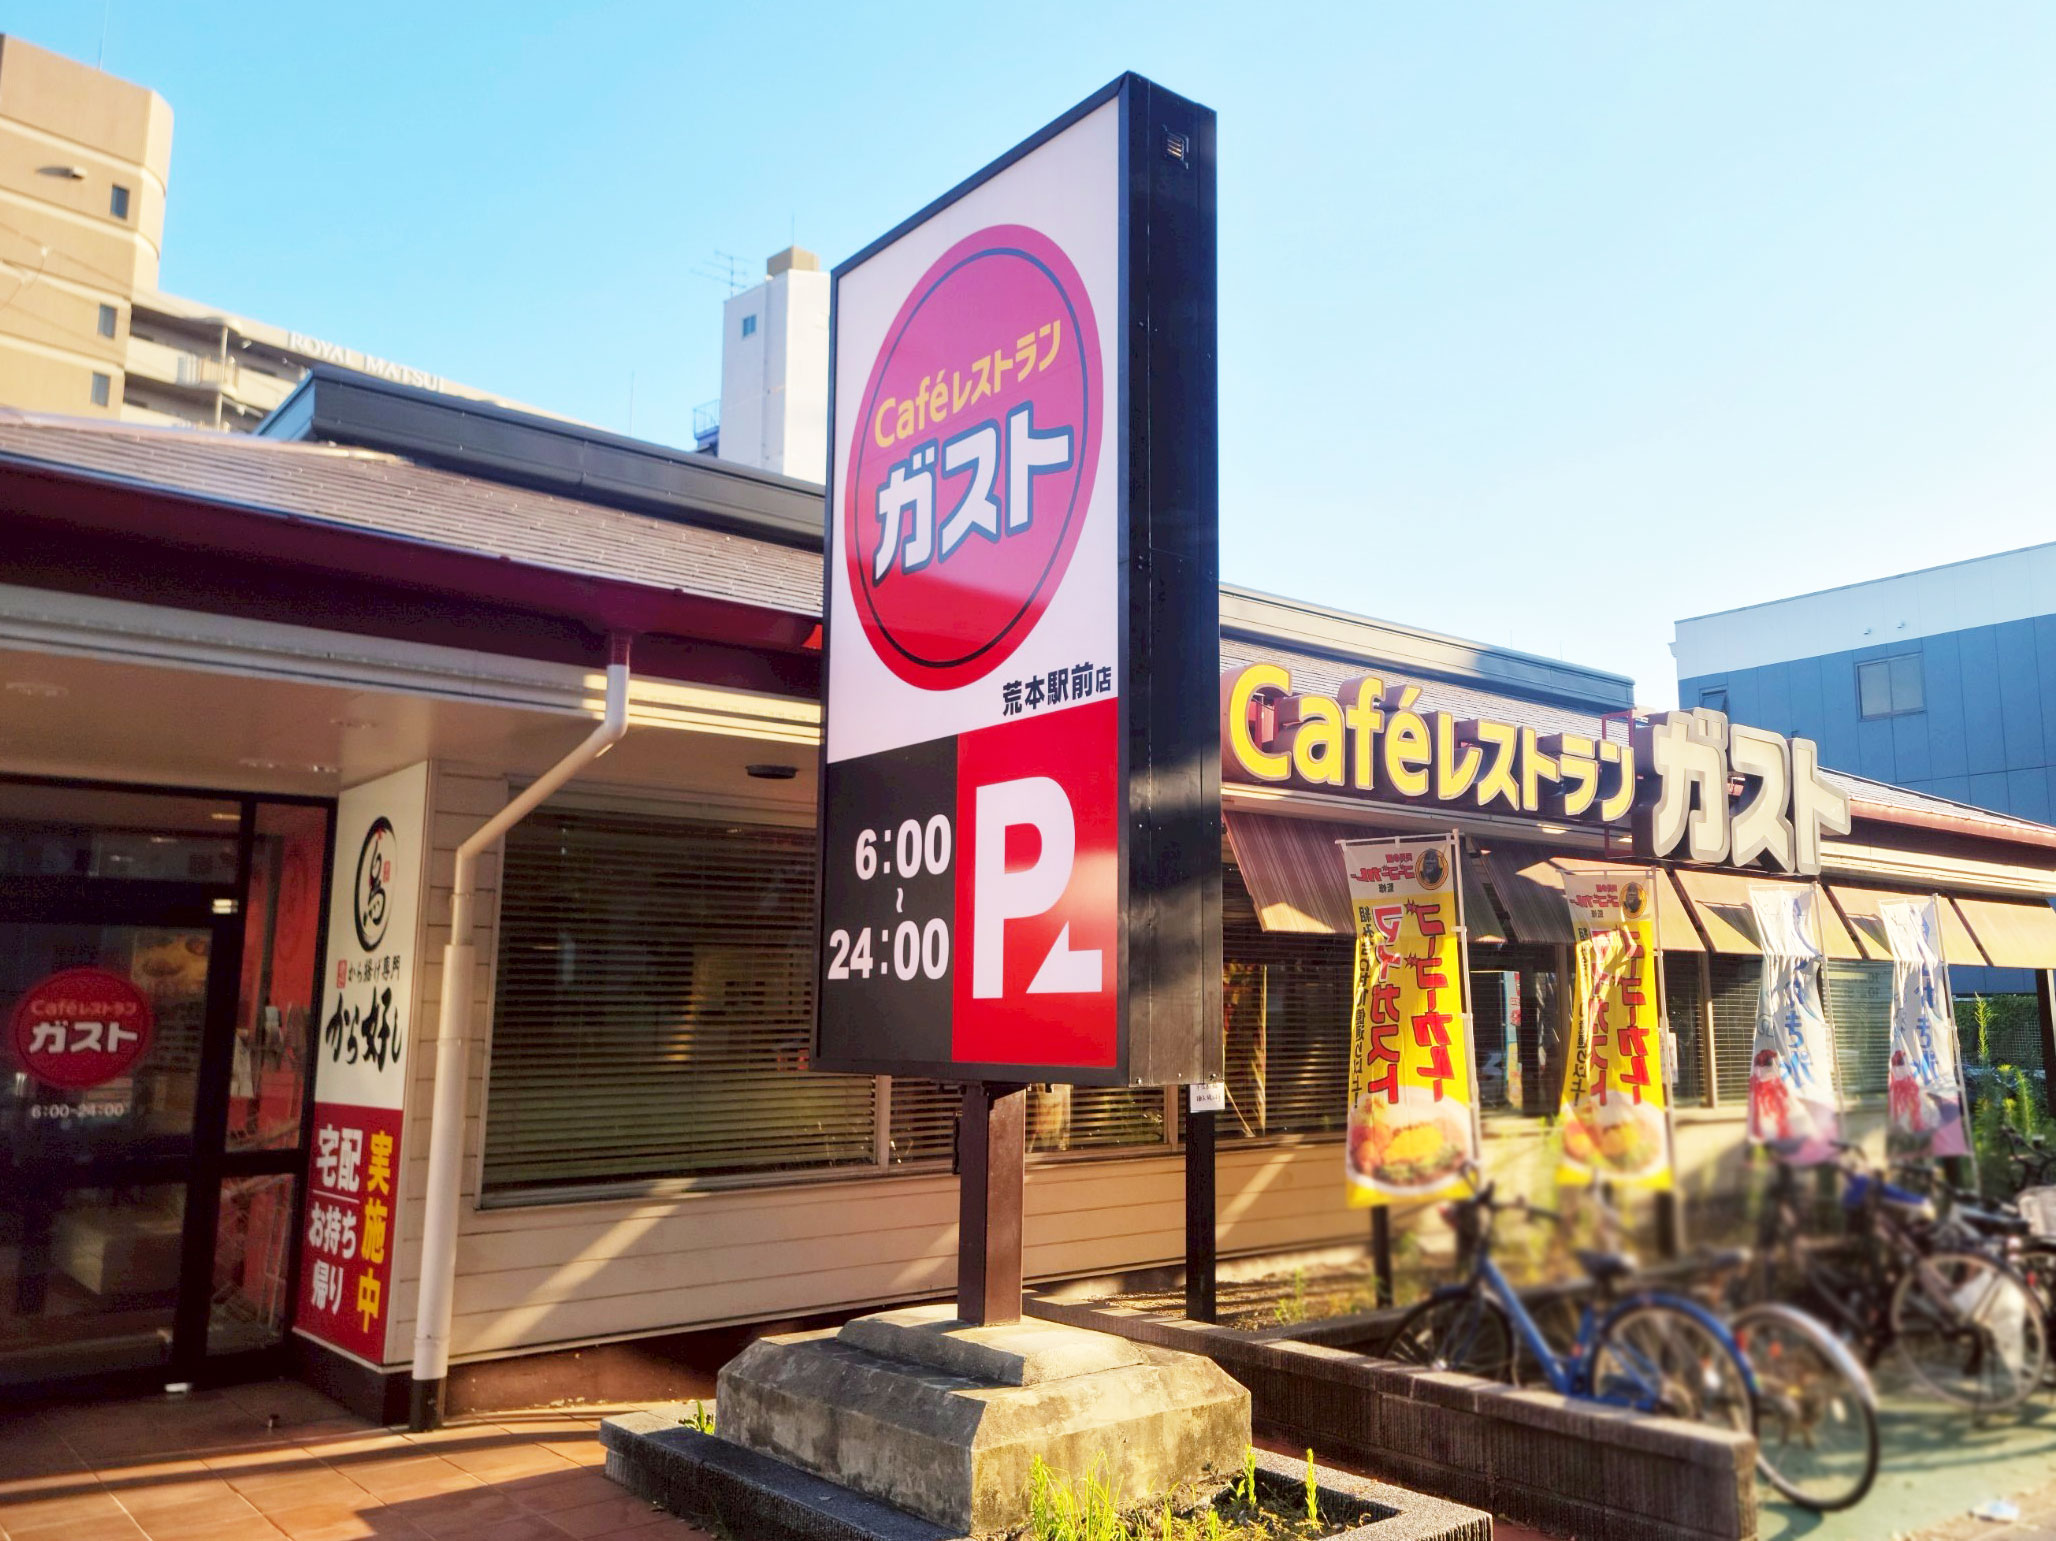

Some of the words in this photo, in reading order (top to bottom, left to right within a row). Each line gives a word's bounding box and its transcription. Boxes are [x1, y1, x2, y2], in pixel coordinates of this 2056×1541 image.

[287, 330, 356, 365] ROYAL
[364, 354, 446, 393] MATSUI
[873, 319, 1062, 449] Caféレストラン
[871, 399, 1075, 588] ガスト
[1002, 661, 1112, 717] 荒本駅前店
[1230, 663, 1635, 823] Caféレストラン
[1650, 706, 1853, 876] ガスト
[855, 814, 952, 881] 6:00
[972, 776, 1076, 1000] P
[827, 917, 950, 982] 24:00
[28, 1020, 138, 1054] ガスト
[315, 1124, 362, 1191] 宅配
[308, 1203, 357, 1260] お持ち
[356, 1129, 394, 1333] 実施中
[311, 1260, 345, 1316] 帰り
